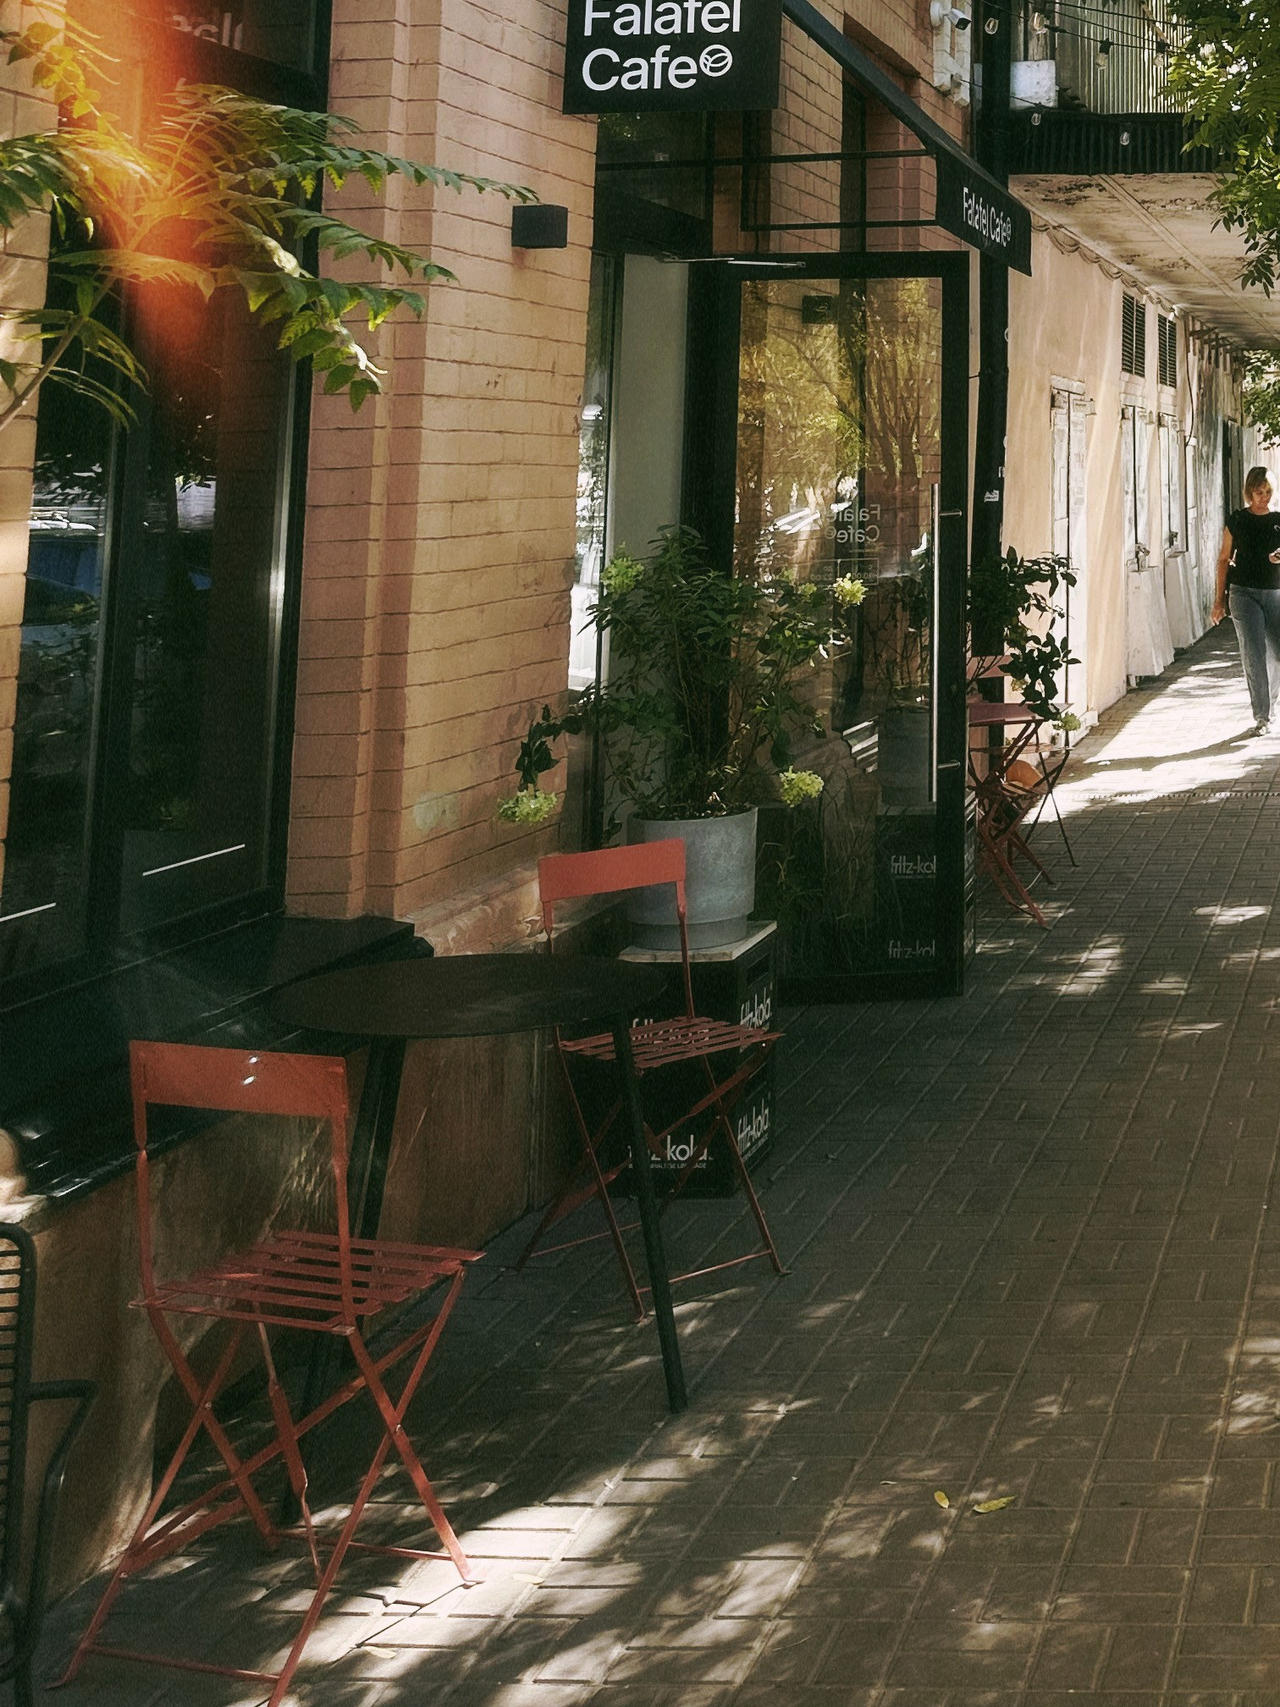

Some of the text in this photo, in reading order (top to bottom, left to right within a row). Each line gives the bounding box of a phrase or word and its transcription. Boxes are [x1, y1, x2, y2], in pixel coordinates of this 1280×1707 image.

[582, 45, 698, 91] Cafe
[963, 187, 1008, 247] Falafel Cafe
